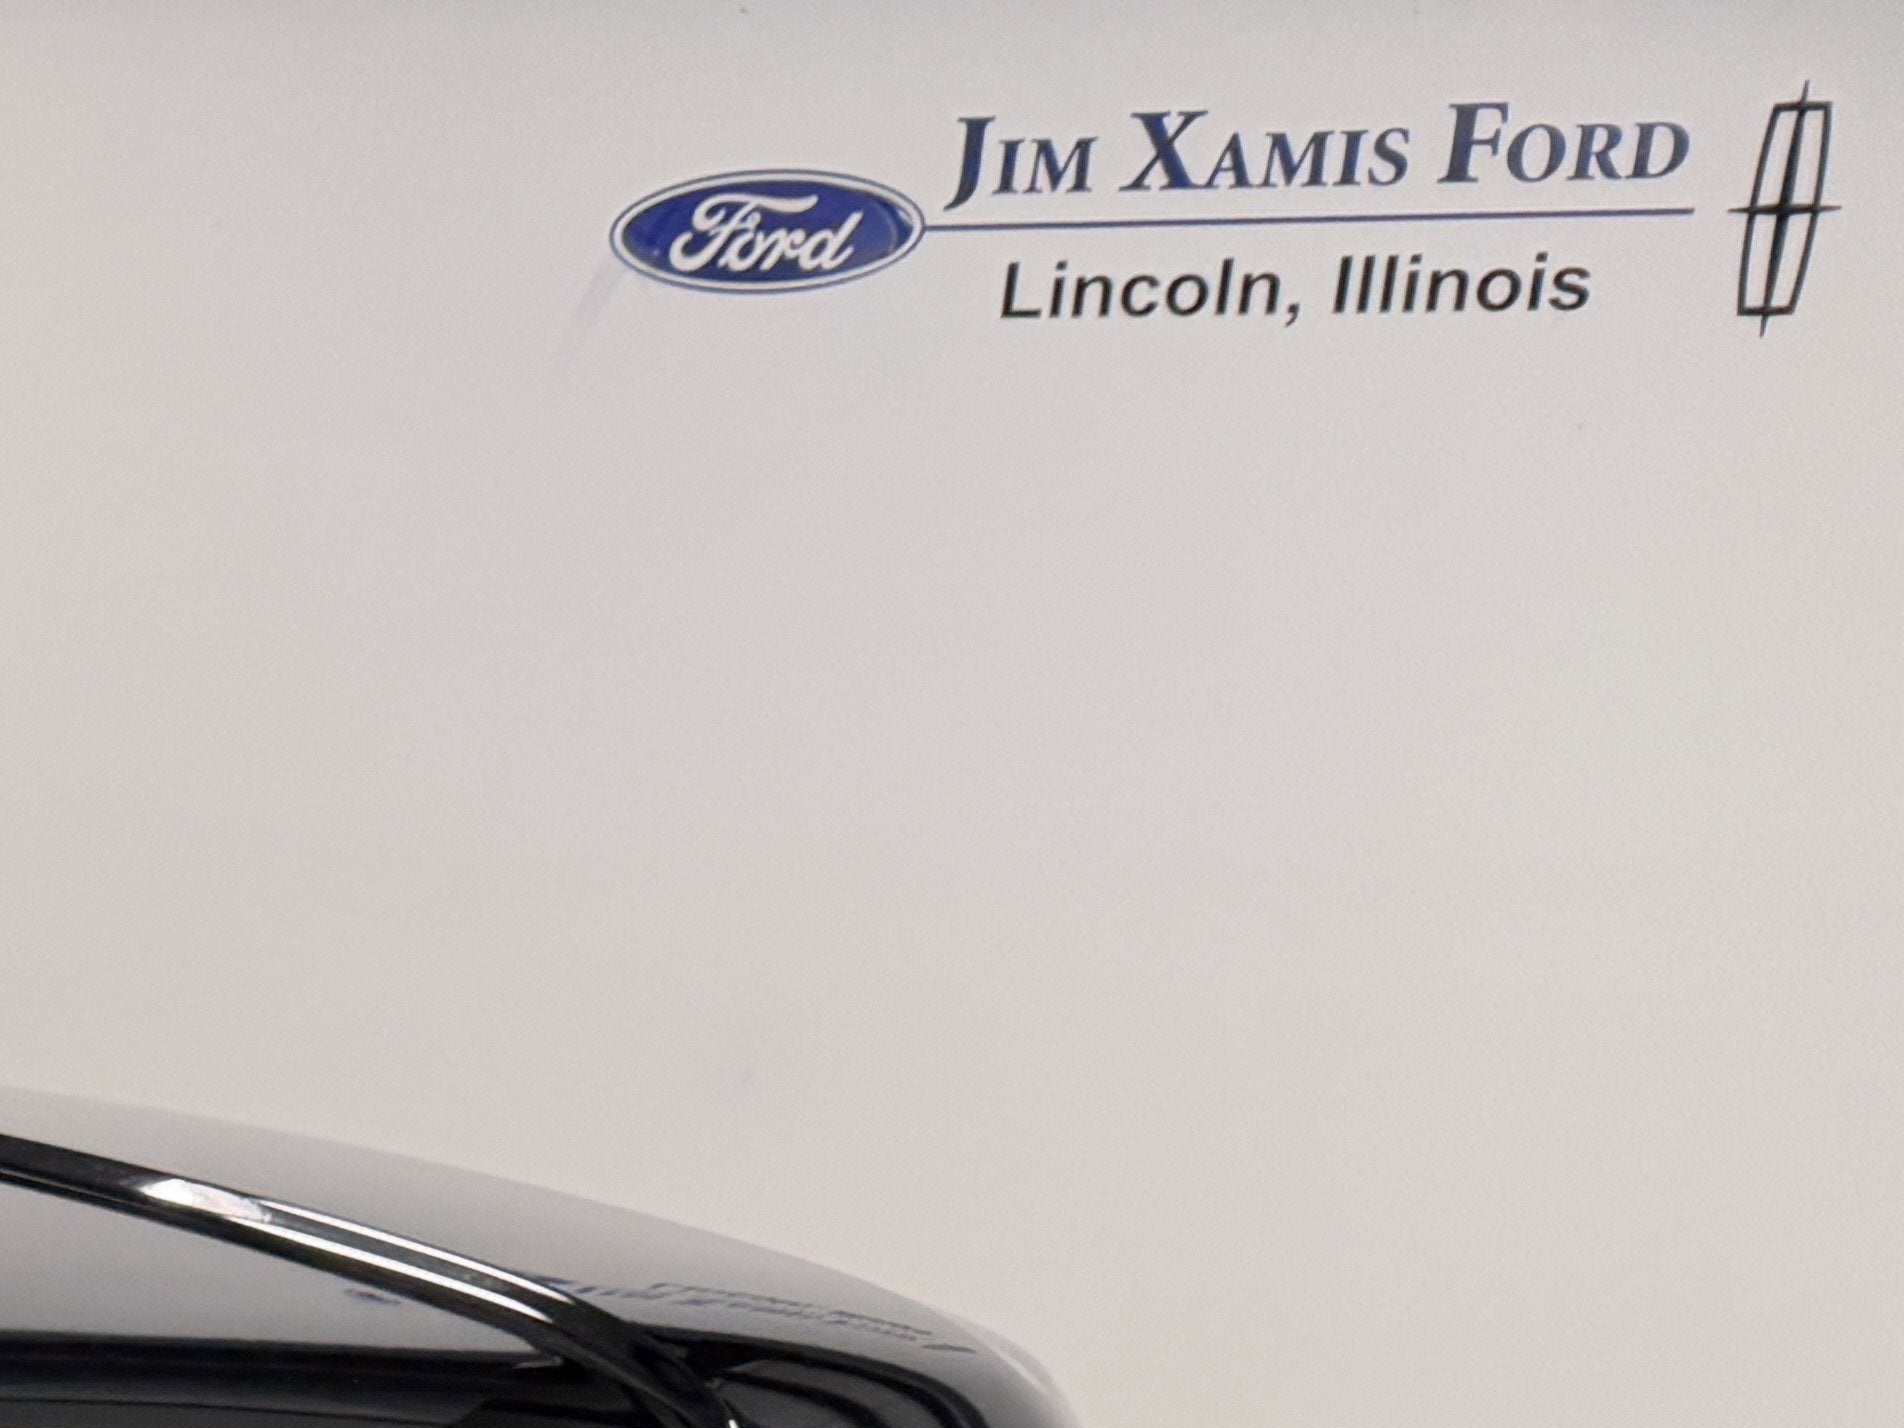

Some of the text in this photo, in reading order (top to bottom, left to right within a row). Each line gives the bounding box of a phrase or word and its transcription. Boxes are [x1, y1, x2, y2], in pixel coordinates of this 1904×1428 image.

[942, 102, 1690, 211] JIM XAMIS FORD
[668, 192, 864, 273] Ford
[1000, 251, 1591, 327] Lincoln, Illinois
